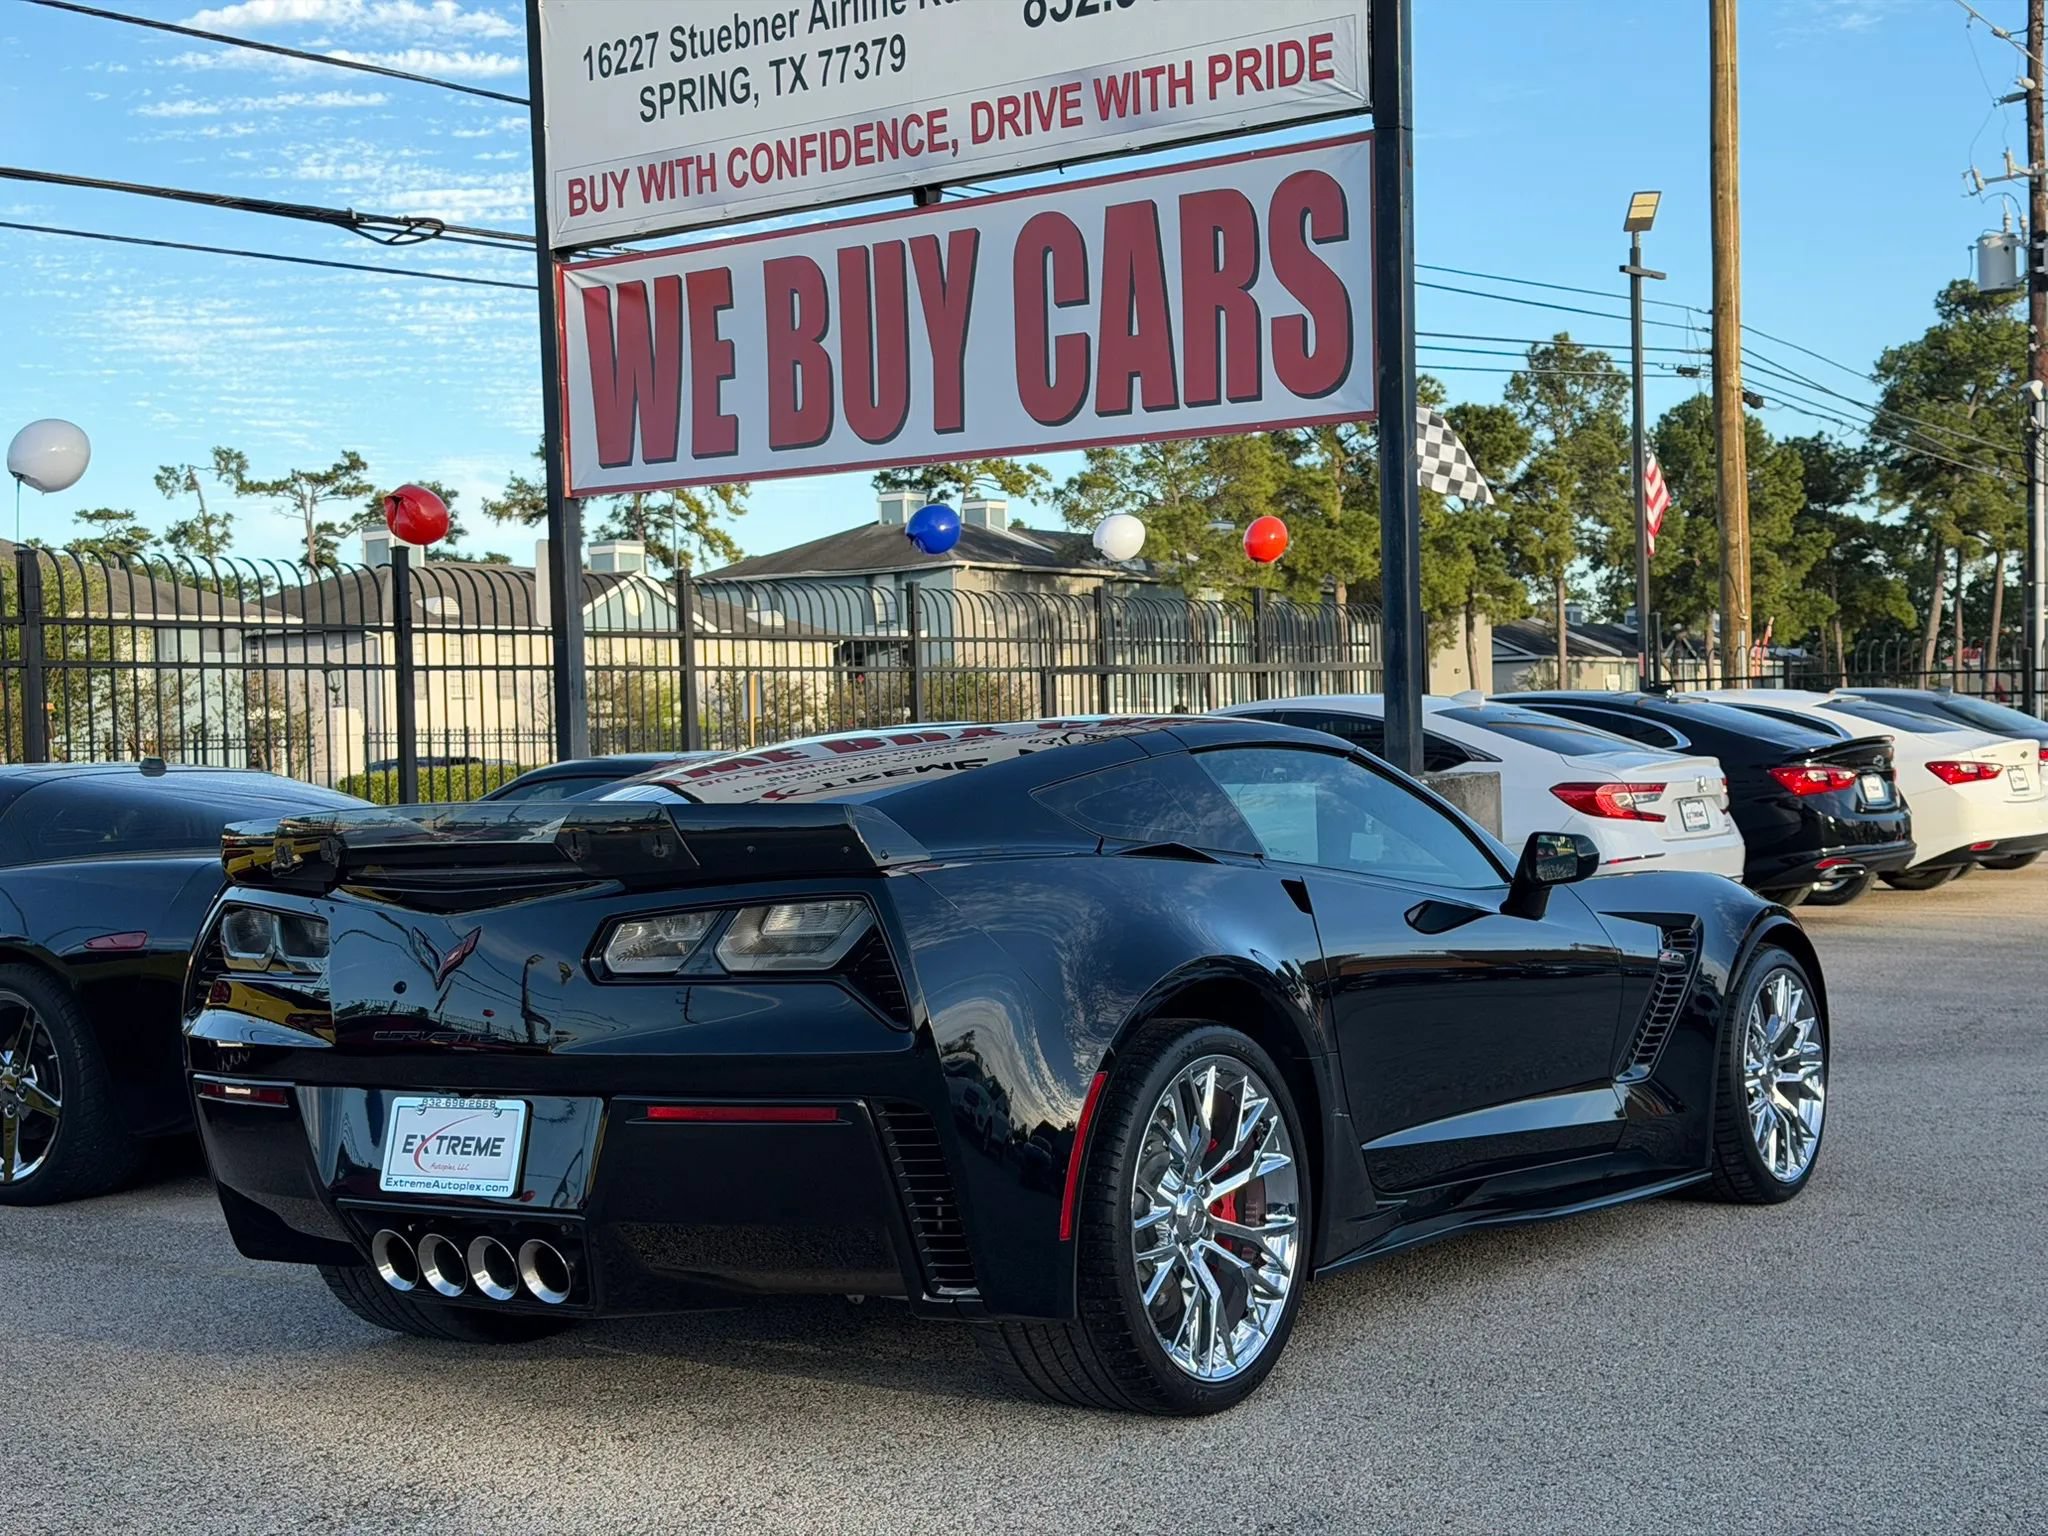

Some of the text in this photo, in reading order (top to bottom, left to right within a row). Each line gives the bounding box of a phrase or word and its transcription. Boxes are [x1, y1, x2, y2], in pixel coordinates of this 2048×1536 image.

[583, 0, 906, 81] 16227 Stuebner Airline
[639, 33, 907, 123] SPRING, TX 77379
[567, 32, 1334, 217] BUY WITH CONFIDENCE, DRIVE WITH PRIDE
[581, 169, 1353, 469] WE BUY CARS
[385, 1177, 509, 1193] ExtremeAutoplex.com
[402, 1134, 506, 1157] EXTREME
